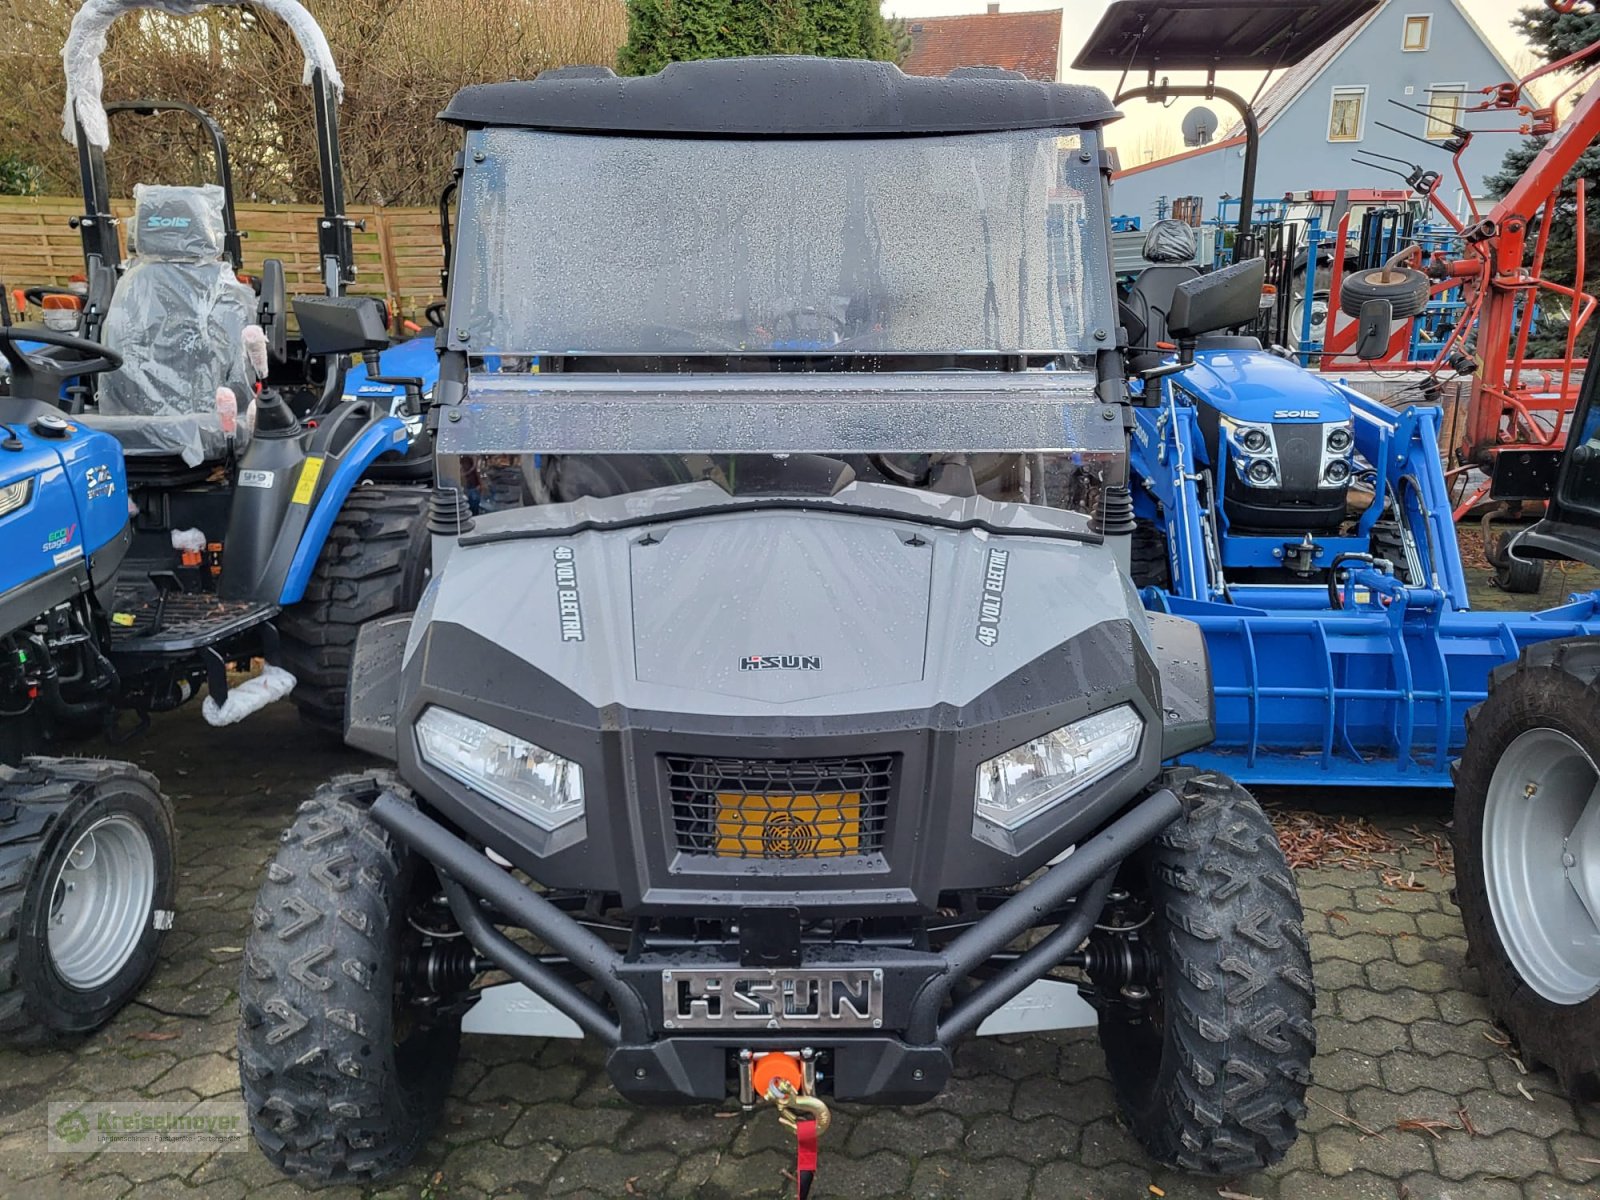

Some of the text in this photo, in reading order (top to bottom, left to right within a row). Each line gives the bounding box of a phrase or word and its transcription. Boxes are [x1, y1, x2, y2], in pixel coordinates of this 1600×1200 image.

[555, 561, 577, 588] VOLT
[558, 590, 585, 642] ELECTRIC
[975, 548, 1009, 647] 48 VOLT ELECTRIC
[739, 656, 822, 671] HSUN
[676, 978, 872, 1020] HSUN
